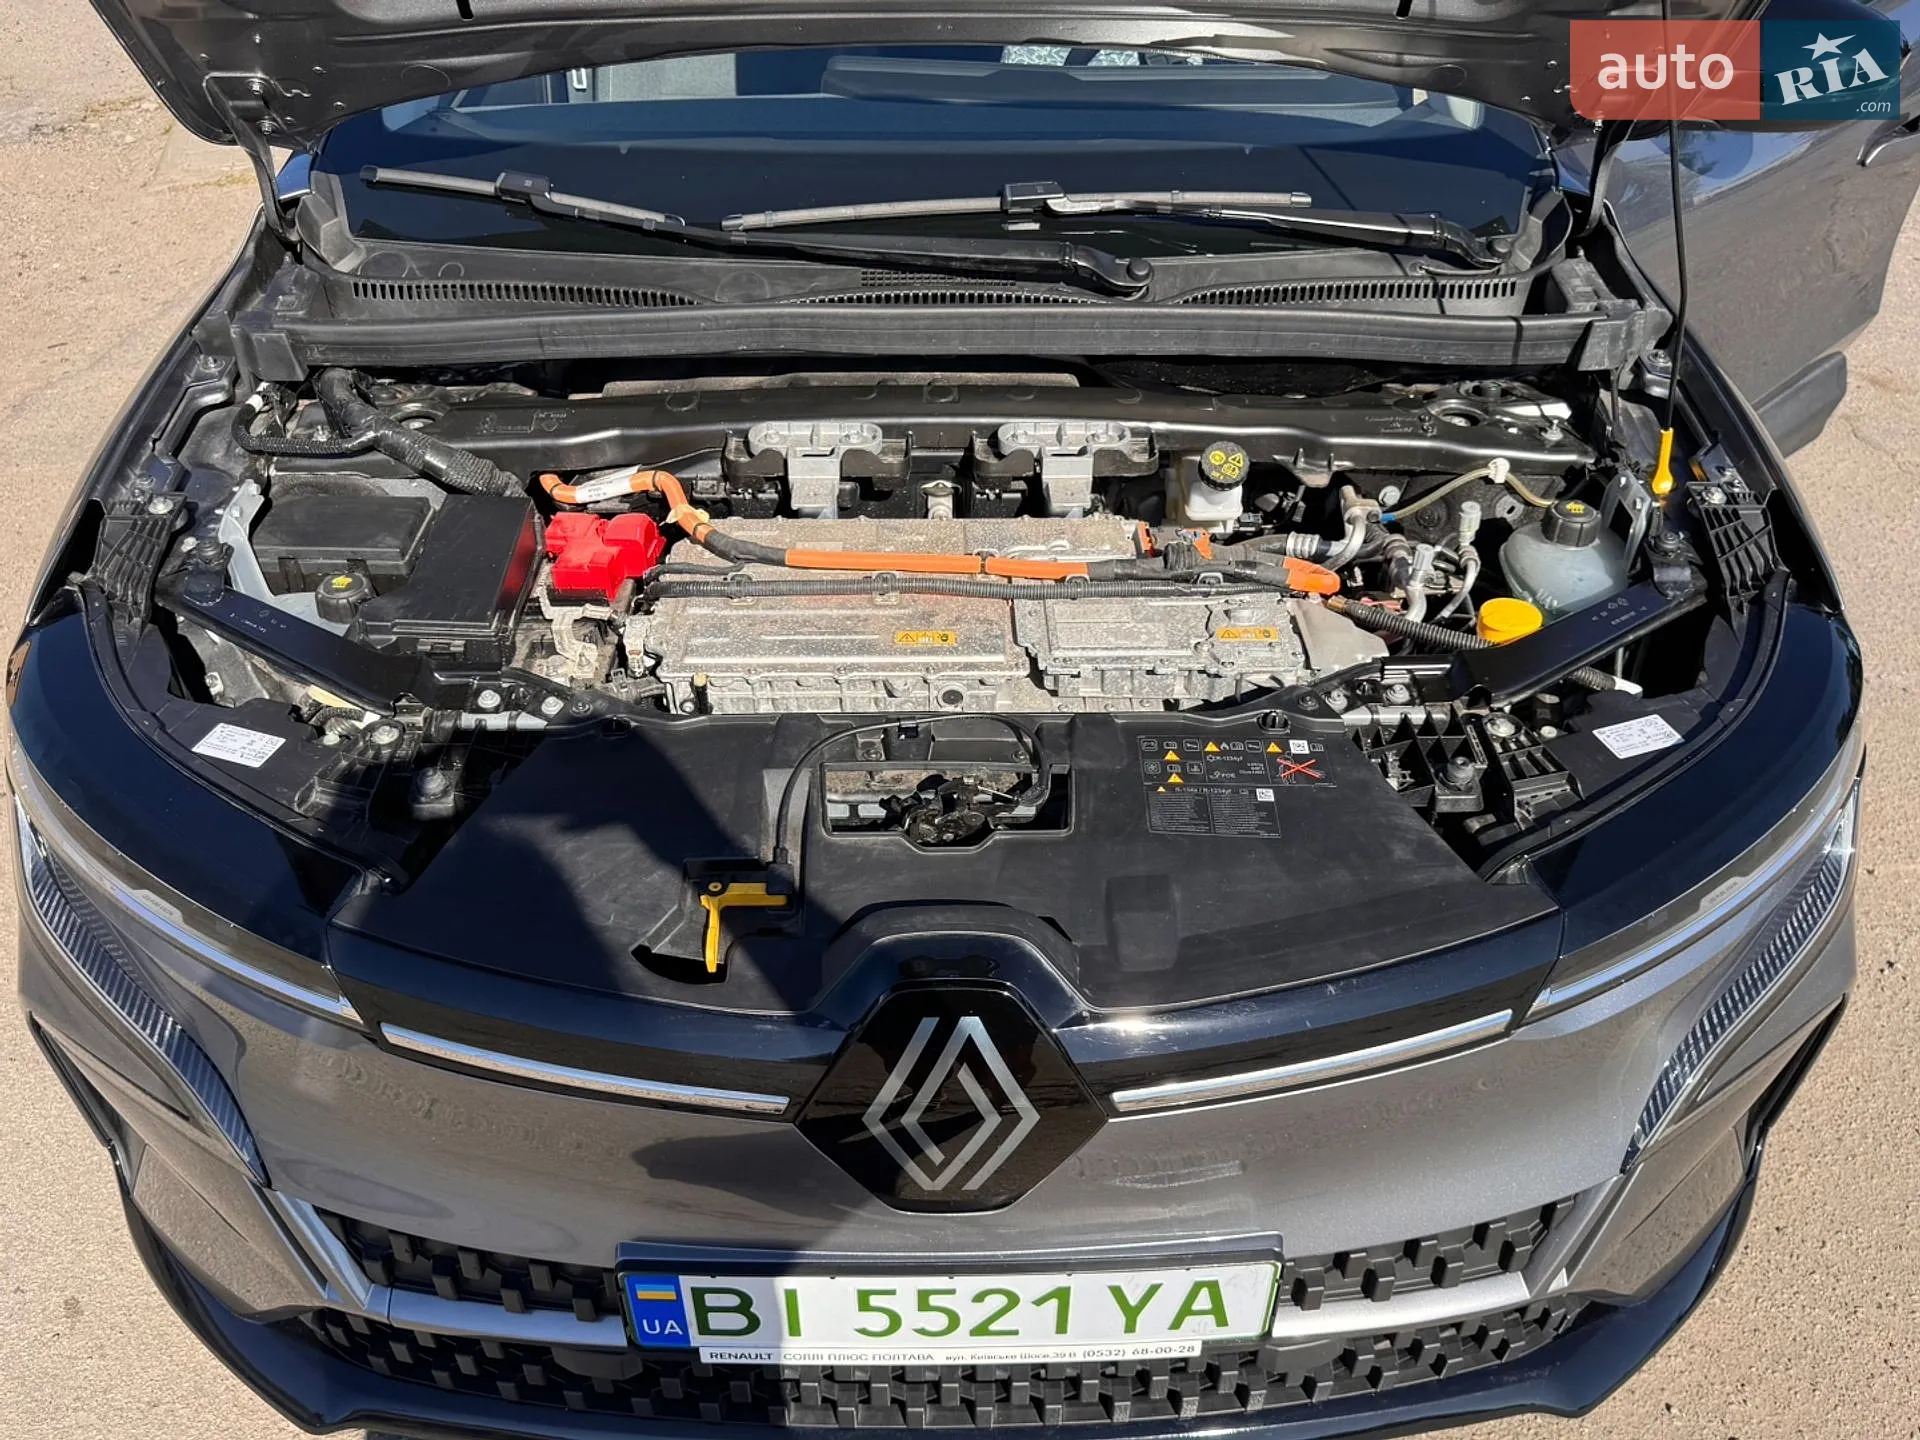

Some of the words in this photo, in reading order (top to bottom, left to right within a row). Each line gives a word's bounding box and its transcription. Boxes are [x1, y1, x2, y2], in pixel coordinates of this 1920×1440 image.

[690, 1286, 801, 1337] BI
[854, 1286, 1072, 1338] 5521
[1107, 1279, 1229, 1335] YA
[642, 1318, 684, 1335] UA
[709, 1352, 774, 1361] RENAULT
[828, 1353, 868, 1361] ПЛЮС
[872, 1353, 934, 1361] ПОЛТАВА
[1083, 1347, 1126, 1359] (0532)
[1131, 1345, 1196, 1356] 68-00-28
